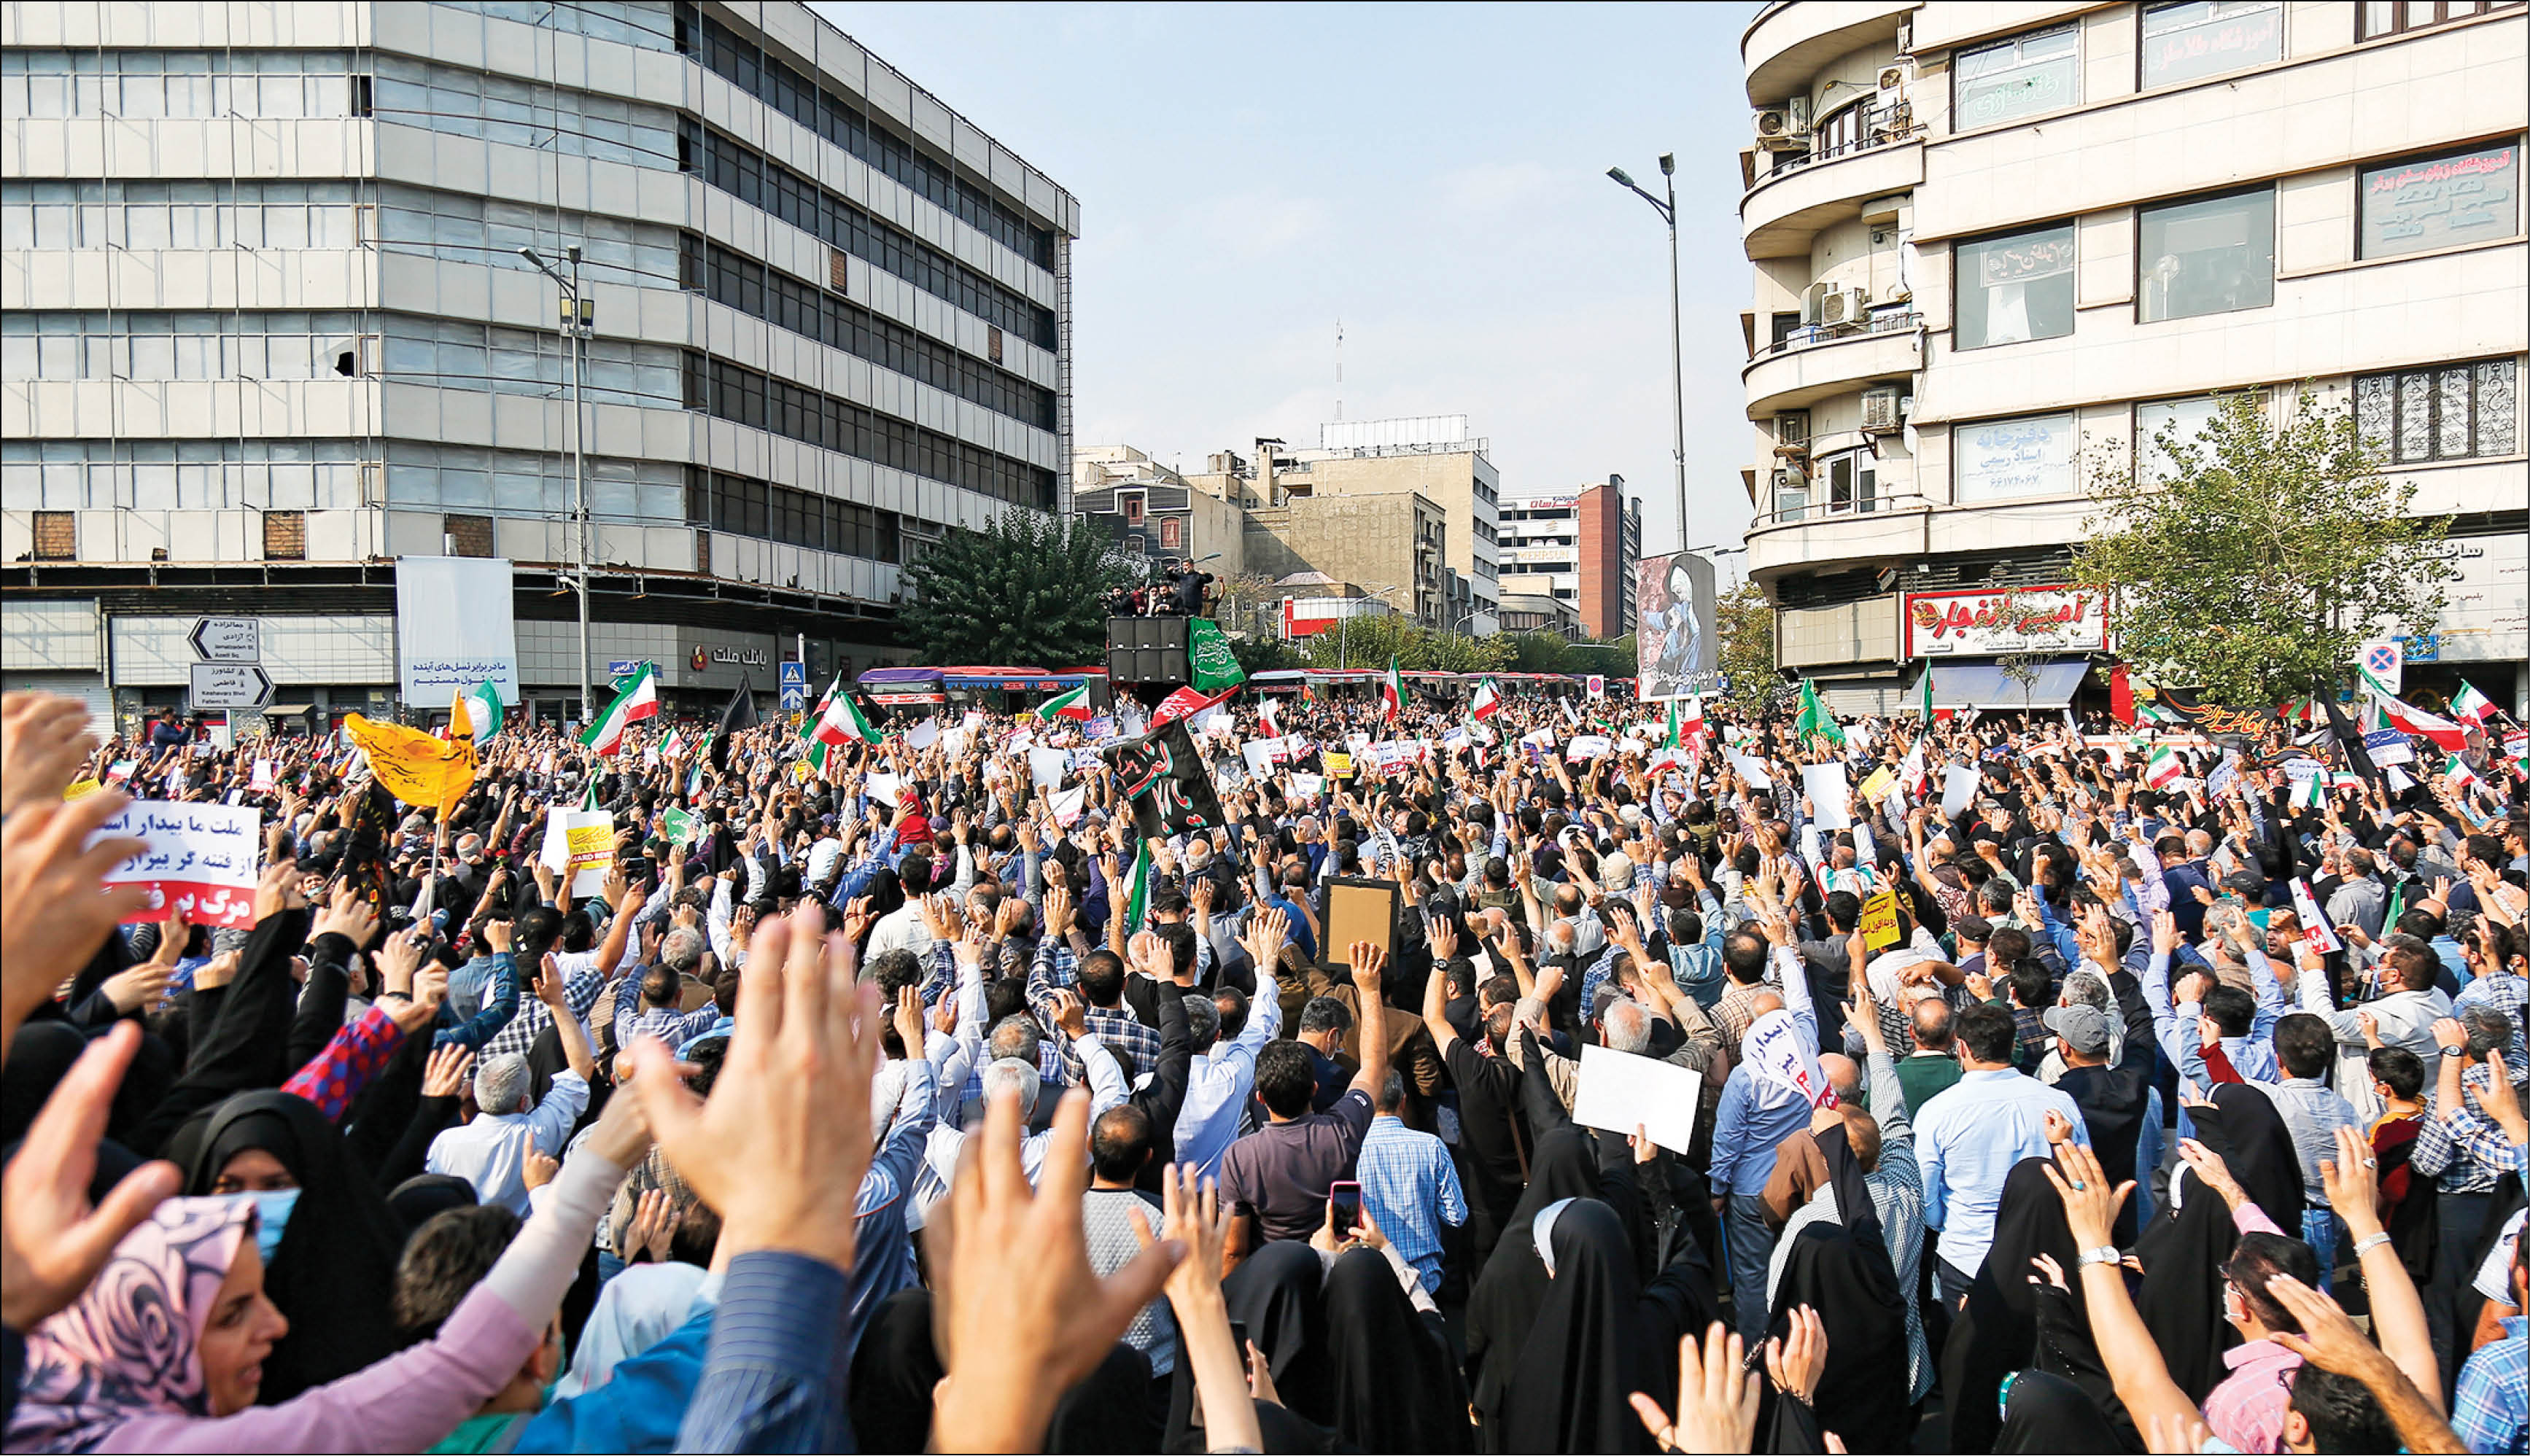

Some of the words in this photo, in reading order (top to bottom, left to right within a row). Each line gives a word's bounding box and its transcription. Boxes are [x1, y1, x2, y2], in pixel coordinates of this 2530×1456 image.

[2014, 449, 2041, 462] اسناد
[713, 647, 739, 664] ملت
[413, 661, 433, 672] آینده
[470, 662, 487, 672] برابر
[497, 662, 506, 671] ما
[414, 676, 460, 687] هستیم
[104, 813, 130, 830] اس
[136, 814, 182, 836] بیدار
[189, 816, 203, 832] ما
[211, 820, 243, 836] ملت
[176, 851, 195, 871] گر
[203, 852, 232, 868] فتنه
[238, 857, 251, 876] از
[176, 891, 195, 917] بر
[200, 889, 250, 924] مرگ
